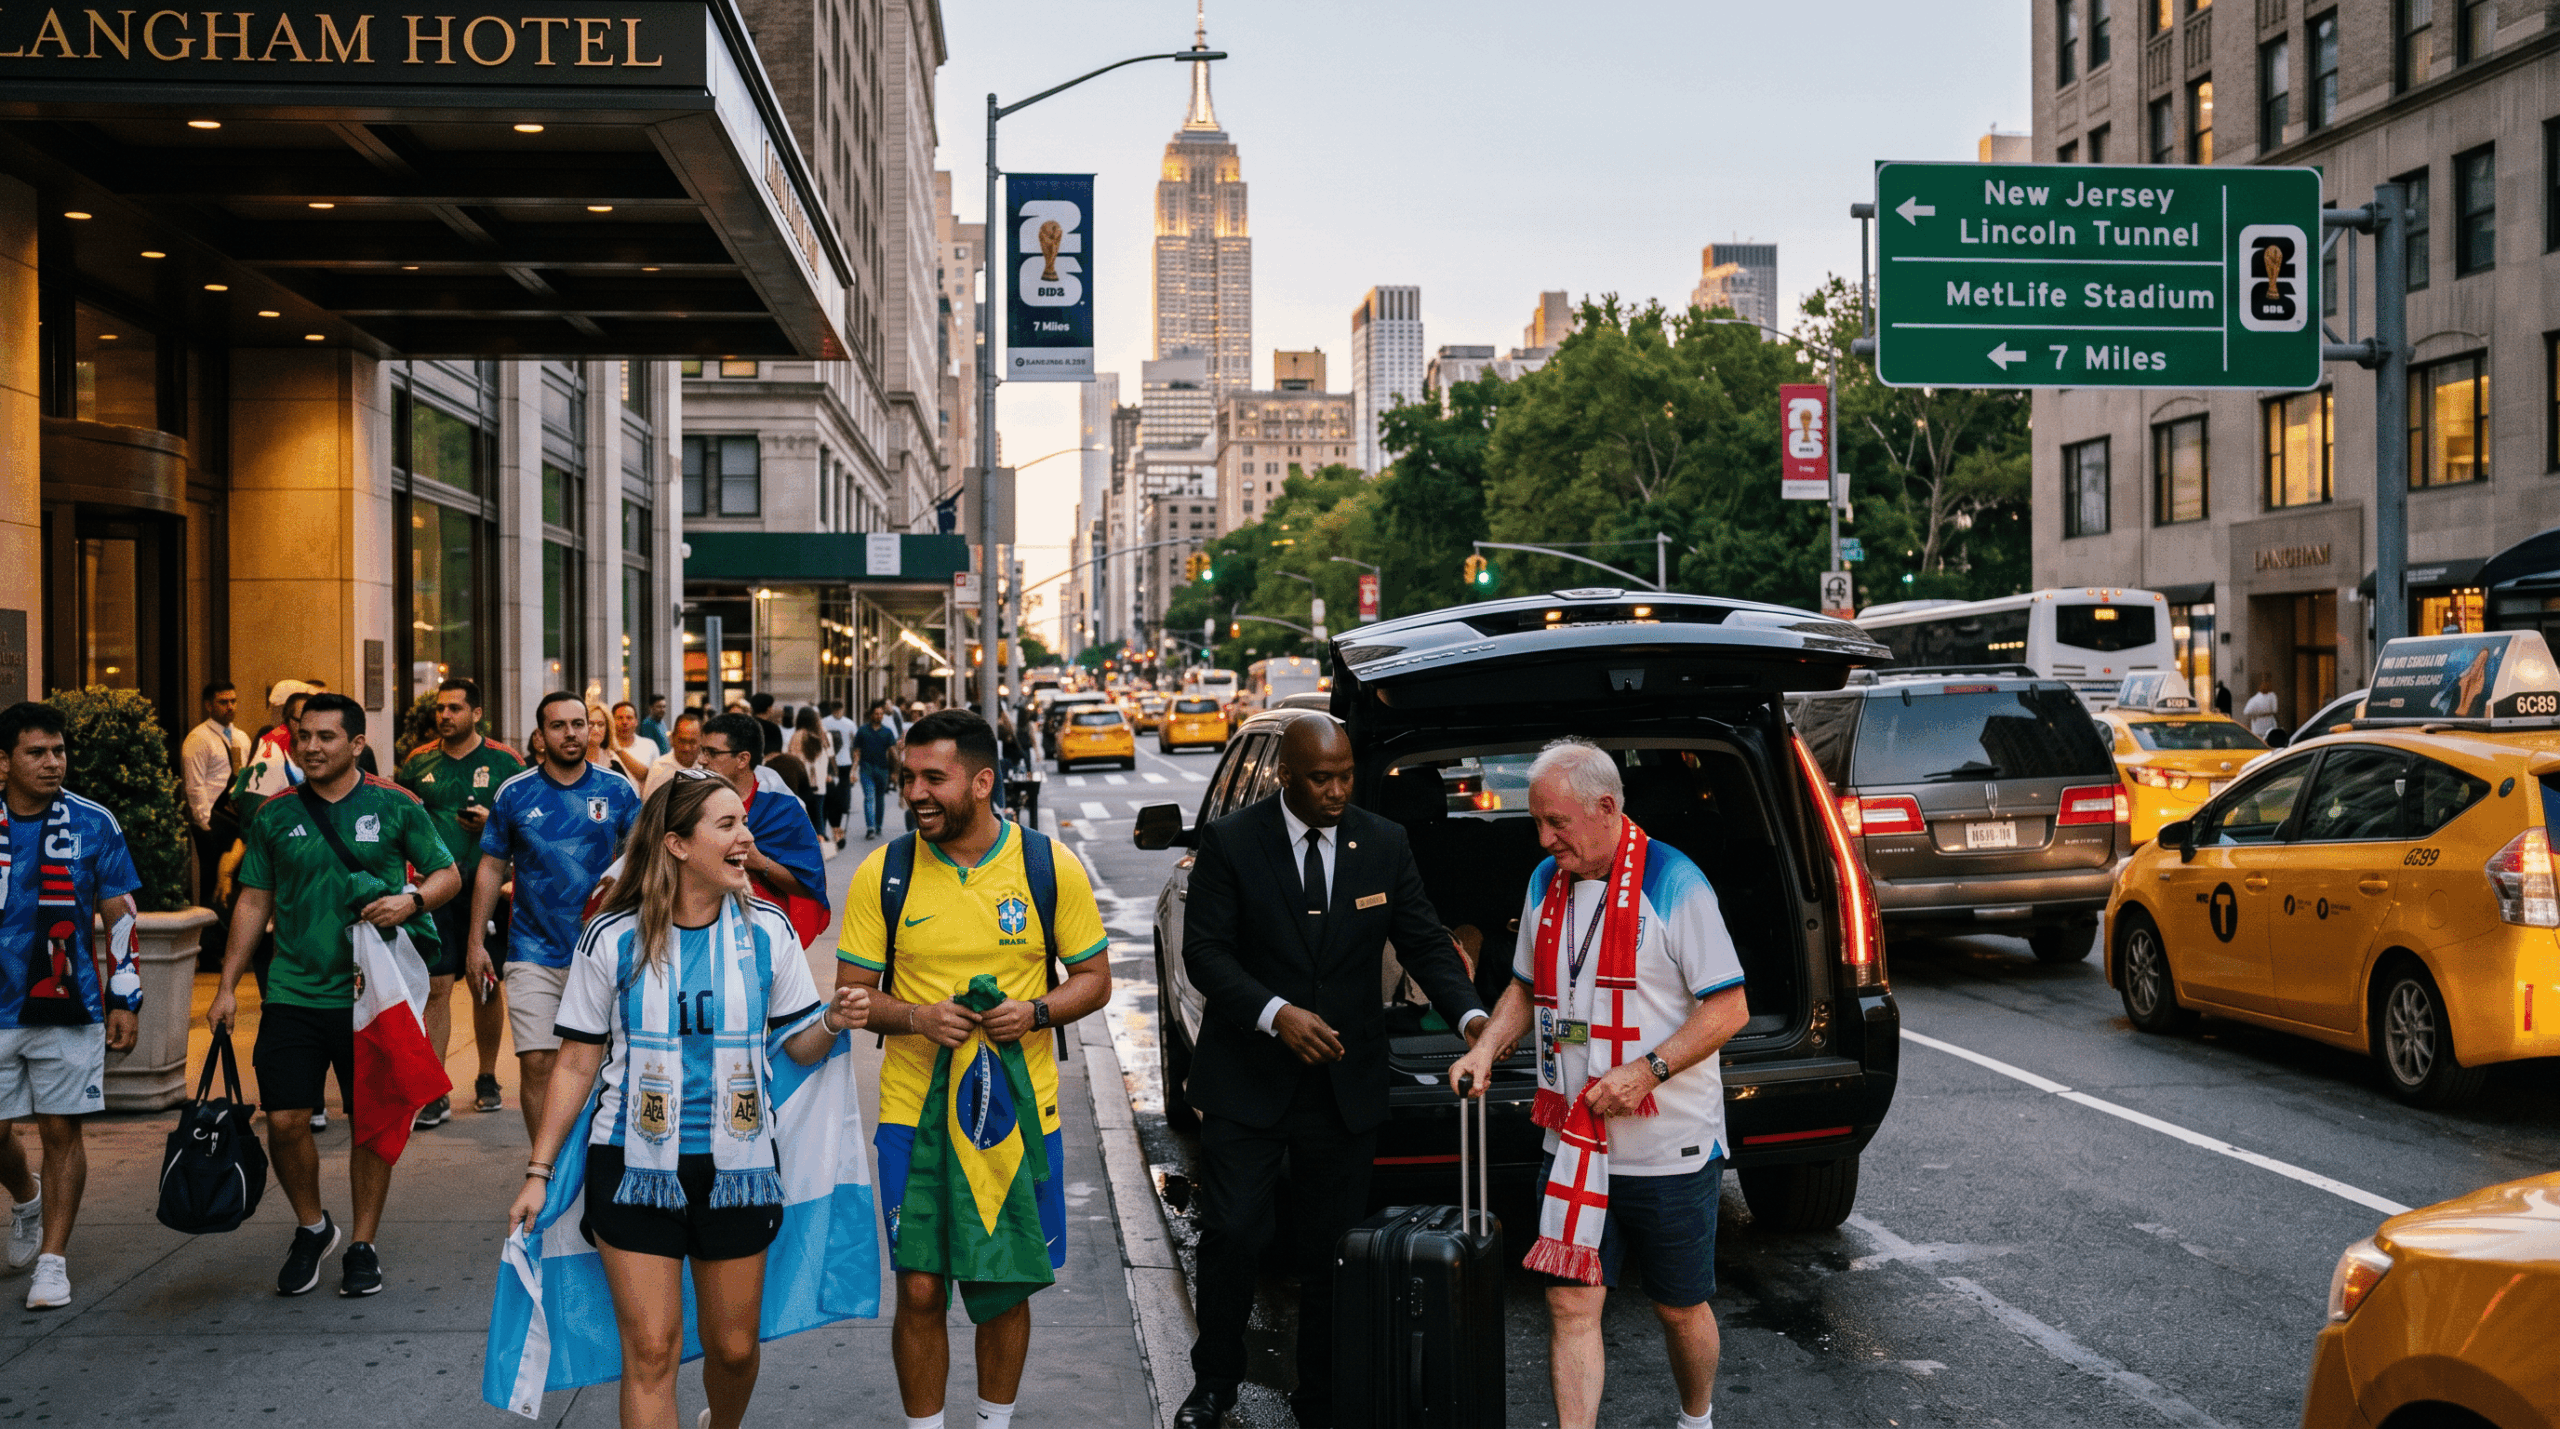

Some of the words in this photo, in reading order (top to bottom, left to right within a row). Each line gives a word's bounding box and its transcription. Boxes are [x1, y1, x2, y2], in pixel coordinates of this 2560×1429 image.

[402, 14, 663, 67] HOTEL
[1984, 179, 2050, 206] New
[2065, 181, 2175, 215] Jersey
[1960, 218, 2076, 245] Lincoln
[2092, 220, 2198, 247] Tunnel
[1946, 281, 2067, 307] MetLife
[2084, 282, 2214, 309] Stadium
[1033, 321, 1040, 332] 7
[2049, 344, 2069, 370] 7
[2085, 345, 2167, 371] Miles
[2516, 695, 2557, 714] 6C89
[2216, 894, 2231, 934] T
[677, 990, 713, 1036] 10
